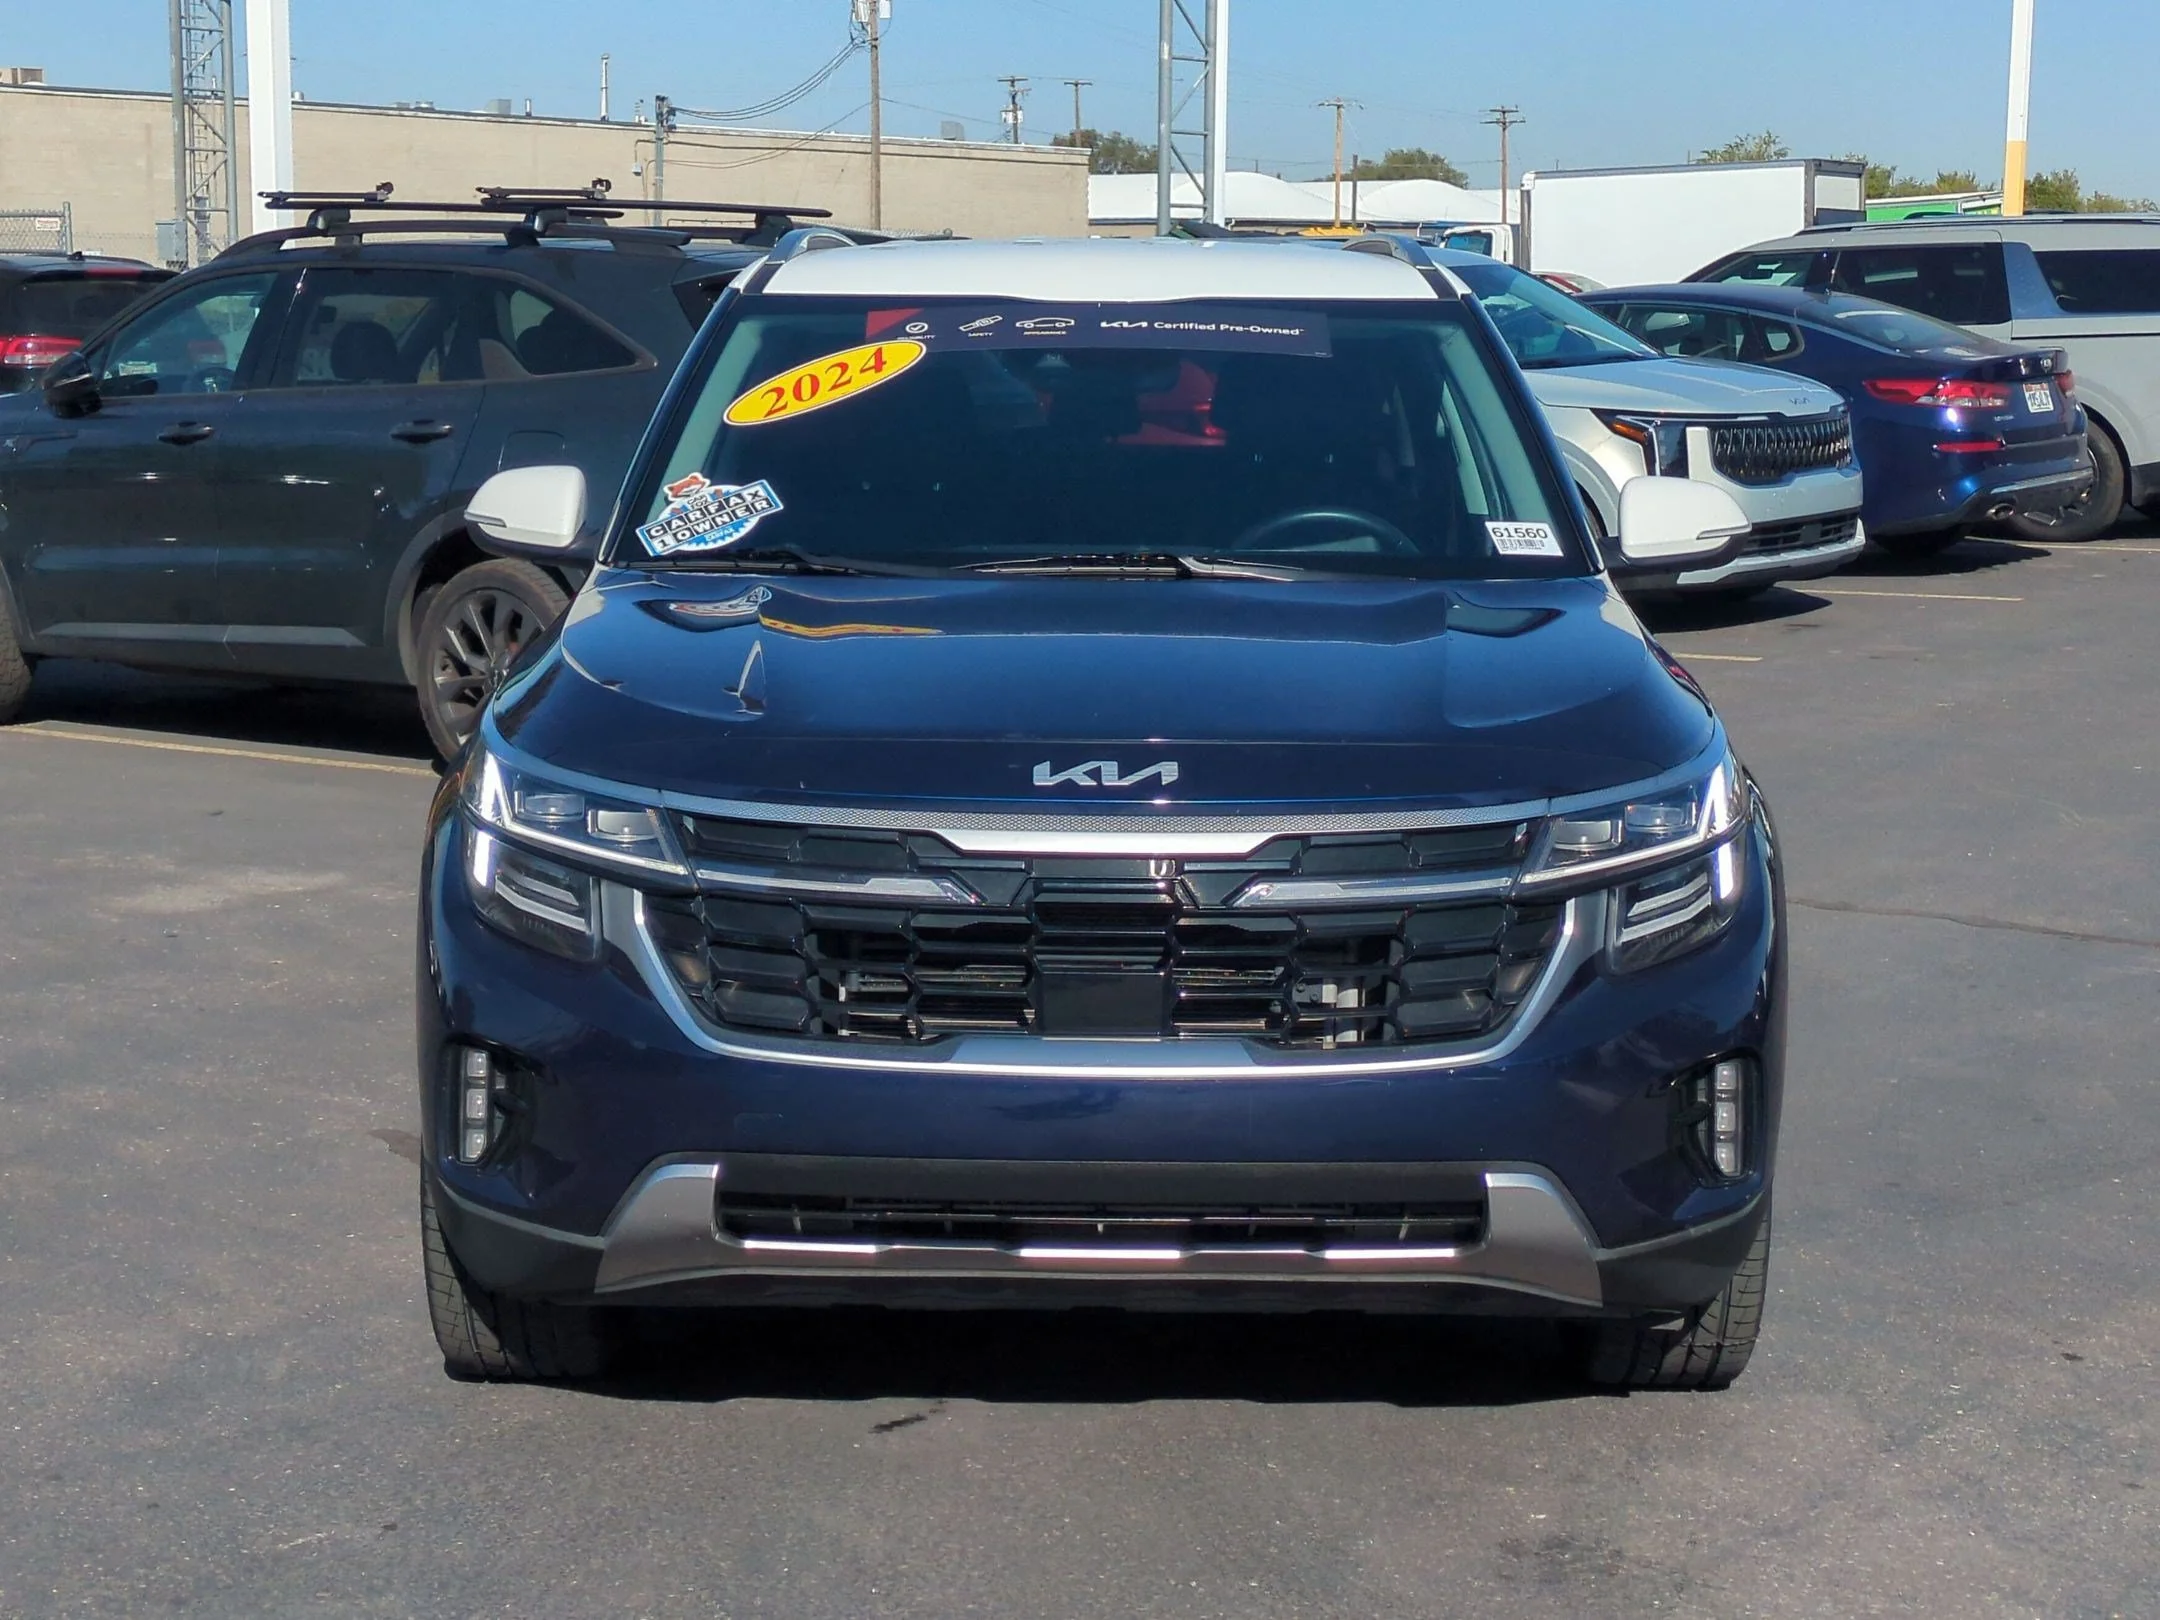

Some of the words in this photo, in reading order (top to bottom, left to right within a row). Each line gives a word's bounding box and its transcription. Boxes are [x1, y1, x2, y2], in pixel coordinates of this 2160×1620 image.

[1153, 321, 1216, 331] Certified
[1219, 324, 1300, 336] Pre-Owned
[760, 346, 888, 419] 2024
[649, 489, 764, 538] CARFAX
[656, 537, 670, 549] 1
[676, 500, 770, 542] OWNER
[1491, 527, 1548, 539] 61560
[1033, 761, 1179, 786] KIA
